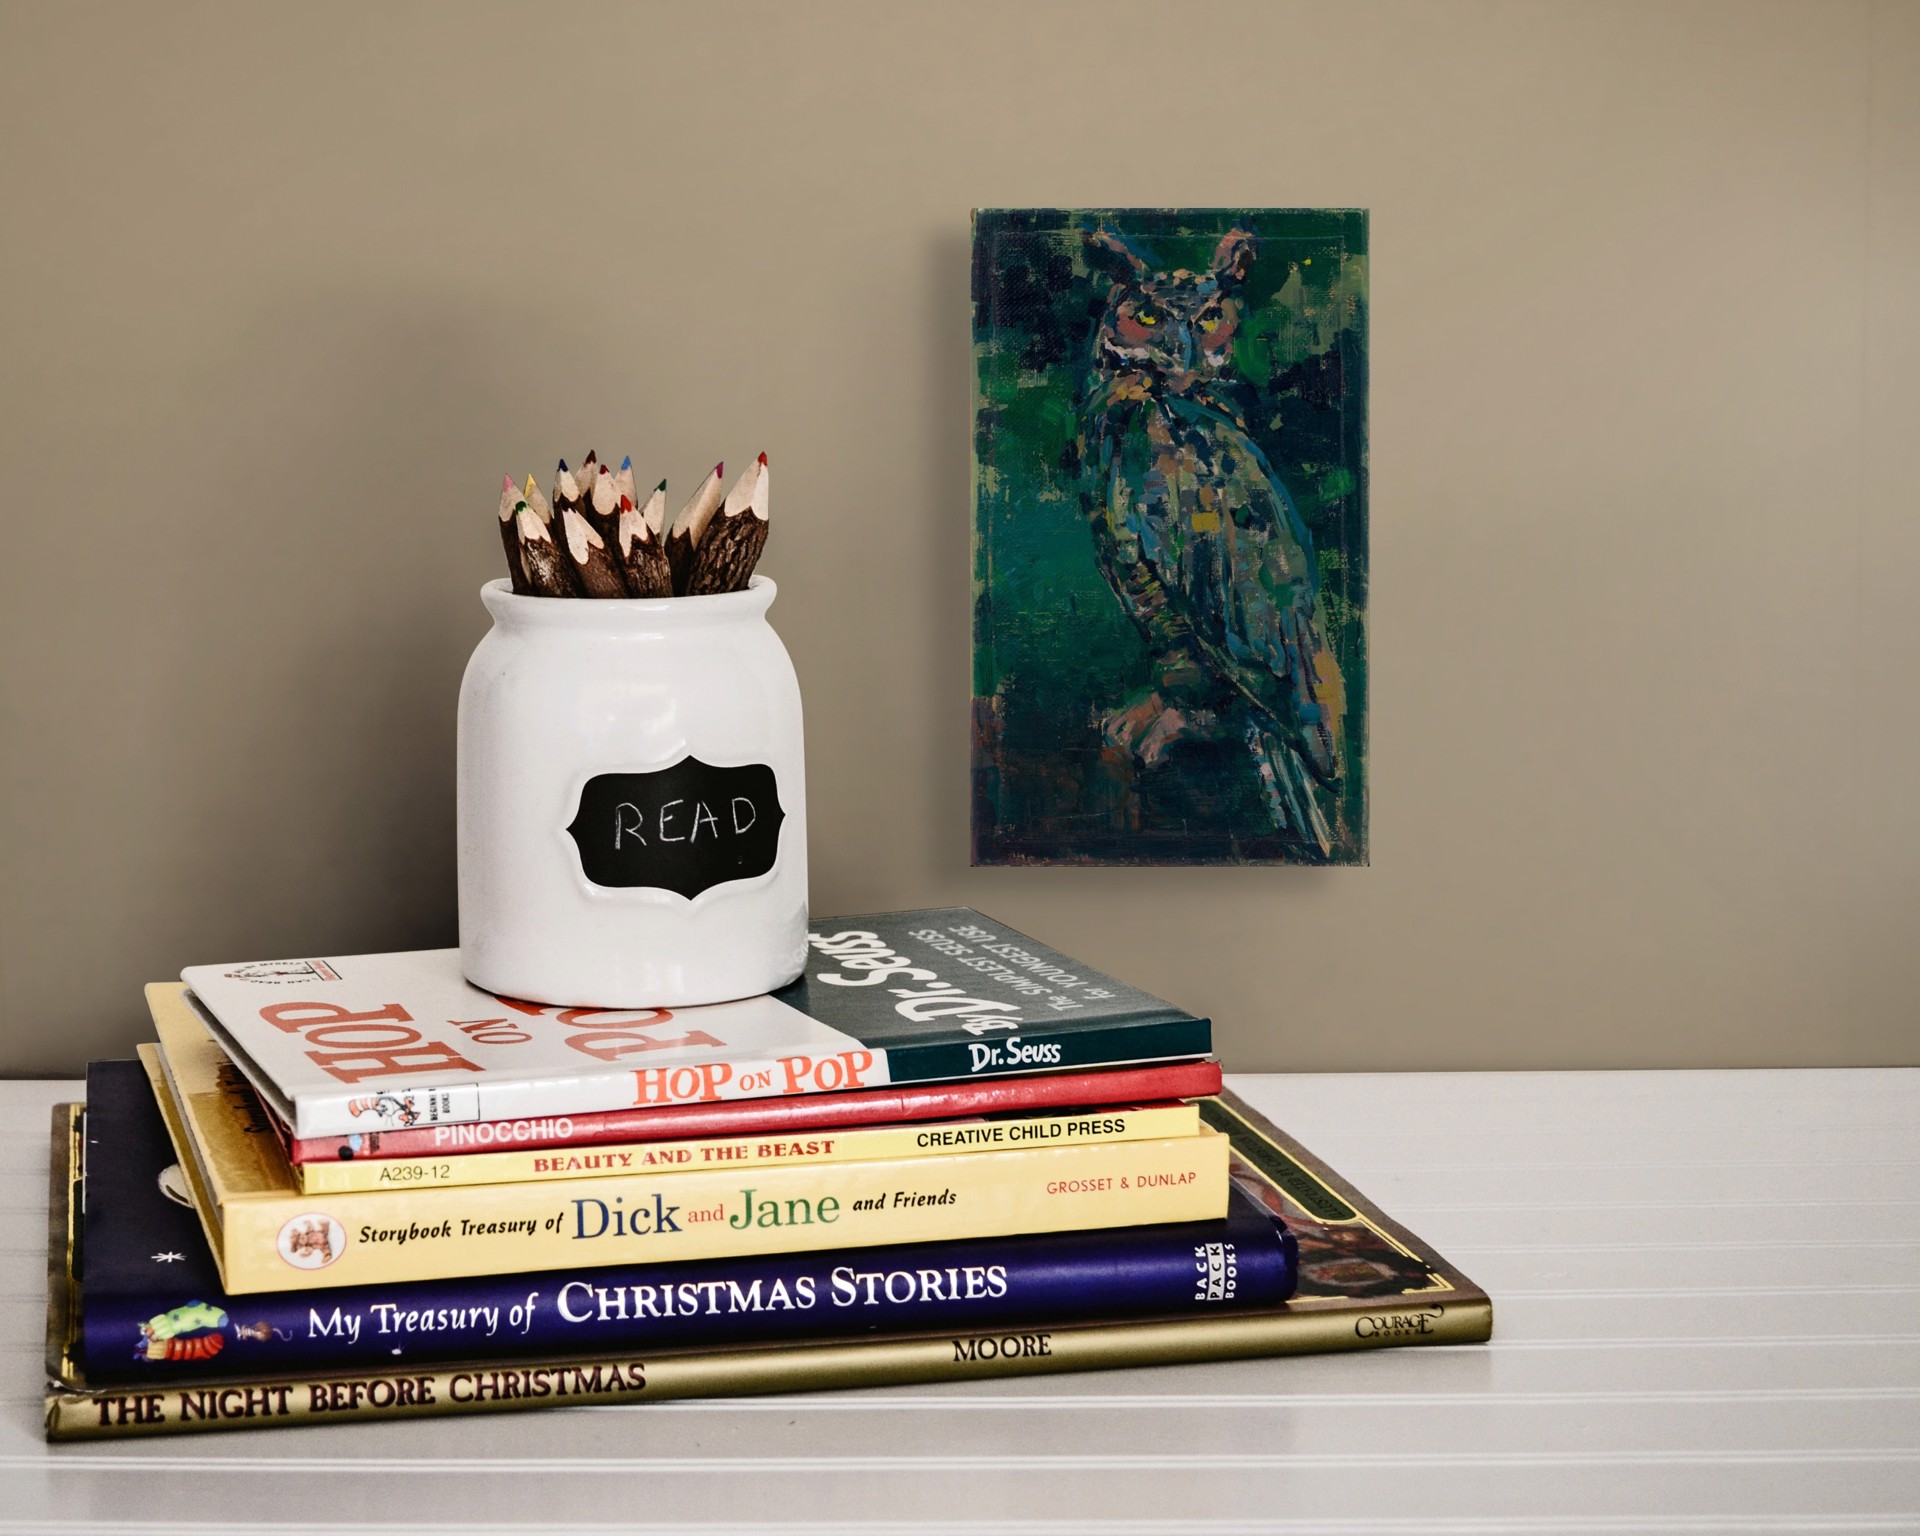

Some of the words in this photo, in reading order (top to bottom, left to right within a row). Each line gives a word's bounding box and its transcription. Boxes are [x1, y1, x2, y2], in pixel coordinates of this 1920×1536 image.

[615, 797, 757, 850] READ
[908, 929, 974, 956] SEUSS
[947, 925, 997, 943] USE
[808, 930, 938, 987] Seuss
[957, 956, 1053, 996] SIMPLEST
[981, 943, 1089, 989] YOUNGEST
[887, 981, 1021, 1022] Dr.
[1047, 995, 1084, 1011] The
[1083, 987, 1116, 1000] for
[259, 1001, 487, 1084] HOP
[447, 1018, 533, 1045] ON
[494, 995, 727, 1062] PO
[957, 1014, 1024, 1036] By
[968, 1043, 1004, 1073] Dr.
[1005, 1037, 1061, 1064] Seuss
[629, 1063, 733, 1106] HOP
[739, 1070, 772, 1092] ON
[776, 1049, 874, 1094] POP
[435, 1118, 573, 1146] PINOCCHIO
[916, 1128, 1004, 1148] CREATIVE
[1008, 1122, 1064, 1142] CHILD
[1067, 1118, 1126, 1138] PRESS
[379, 1165, 450, 1182] A239-12
[533, 1152, 633, 1173] BEAUTY
[643, 1149, 692, 1165] AND
[700, 1143, 749, 1162] THE
[758, 1140, 835, 1159] BEAST
[1046, 1178, 1113, 1194] GROSSET
[1120, 1177, 1130, 1189] &
[1137, 1172, 1196, 1188] DUNLAP
[359, 1223, 452, 1245] Storybook
[460, 1219, 536, 1237] Treasury
[545, 1212, 564, 1235] of
[571, 1193, 682, 1240] Dick
[687, 1203, 724, 1222] and
[730, 1188, 840, 1230] Jane
[852, 1192, 886, 1211] and
[893, 1189, 957, 1209] Friends
[1194, 1246, 1208, 1300] BACK
[1209, 1246, 1222, 1299] PACK
[1224, 1243, 1237, 1299] BOOKS
[308, 1307, 361, 1346] My
[370, 1302, 500, 1337] Treasury
[509, 1292, 538, 1334] of
[557, 1276, 816, 1323] CHRISTMAS
[830, 1265, 1007, 1307] STORIES
[1355, 1304, 1444, 1338] COURAGE
[953, 1333, 1052, 1363] MOORE
[92, 1394, 165, 1426] THE
[179, 1386, 293, 1422] NIGHT
[308, 1377, 436, 1414] BEFORE
[448, 1363, 647, 1403] CHRISTMAS
